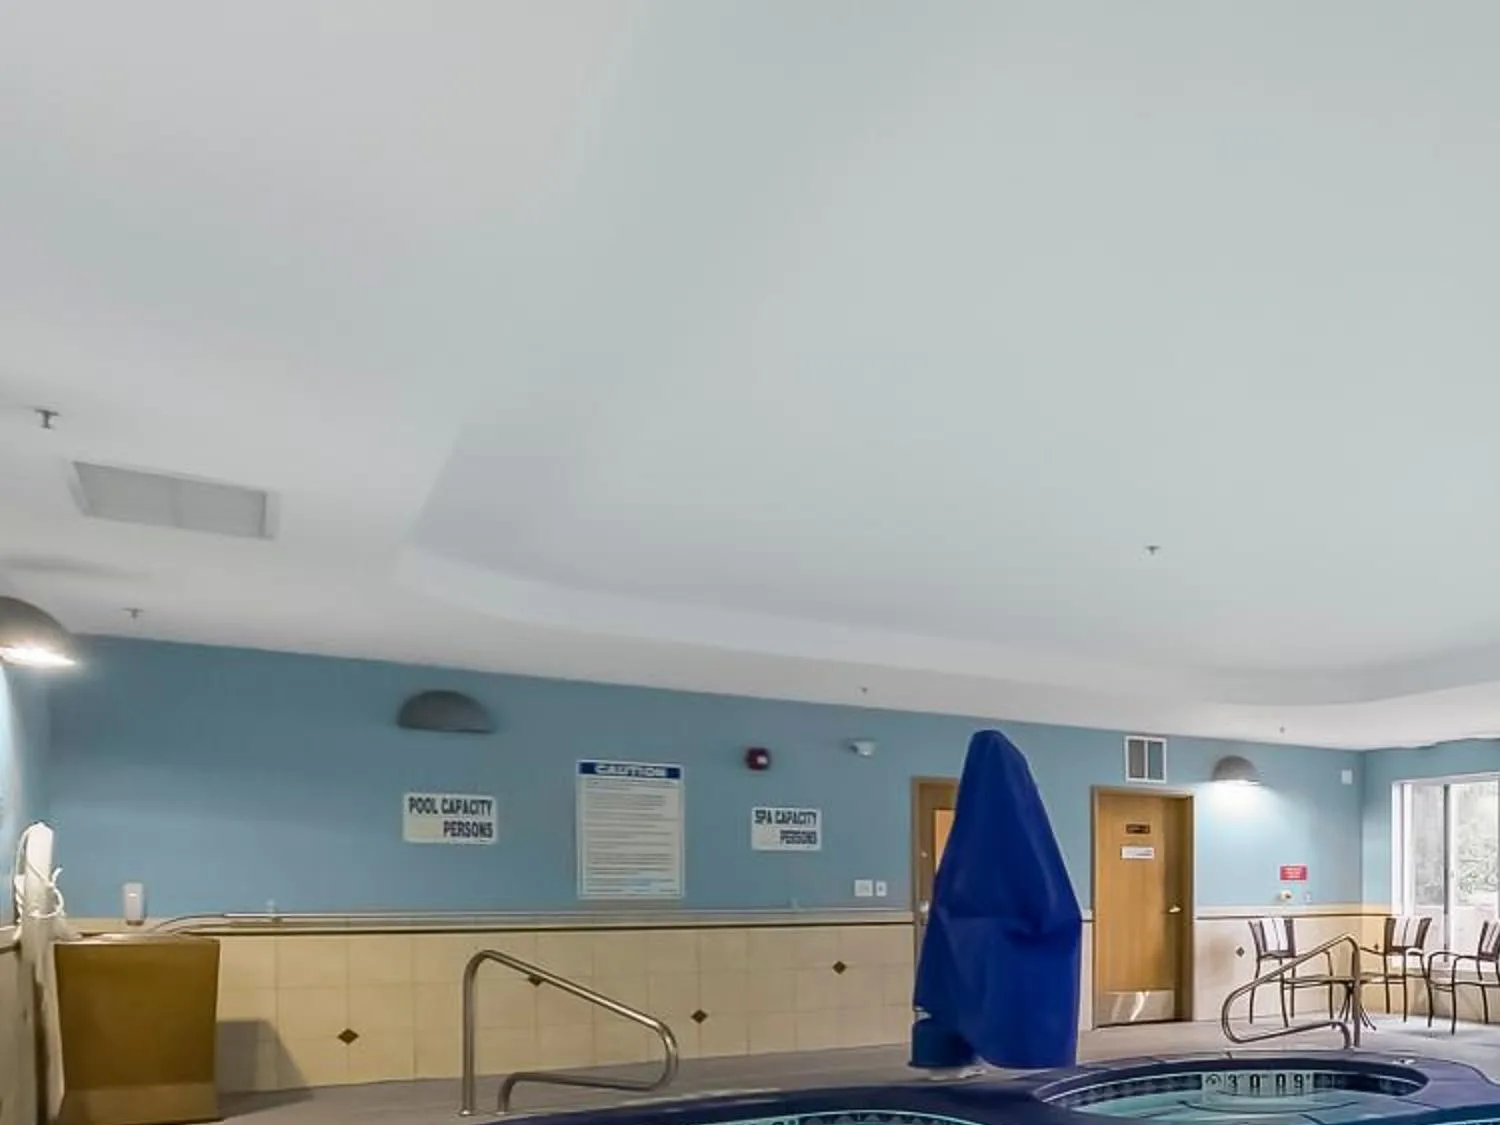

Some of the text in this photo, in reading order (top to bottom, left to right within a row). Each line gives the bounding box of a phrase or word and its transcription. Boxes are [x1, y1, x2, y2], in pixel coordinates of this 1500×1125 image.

[408, 796, 493, 816] POOL CAPACITY
[755, 810, 816, 824] SPA CAPACITY
[443, 820, 493, 838] PERSONS
